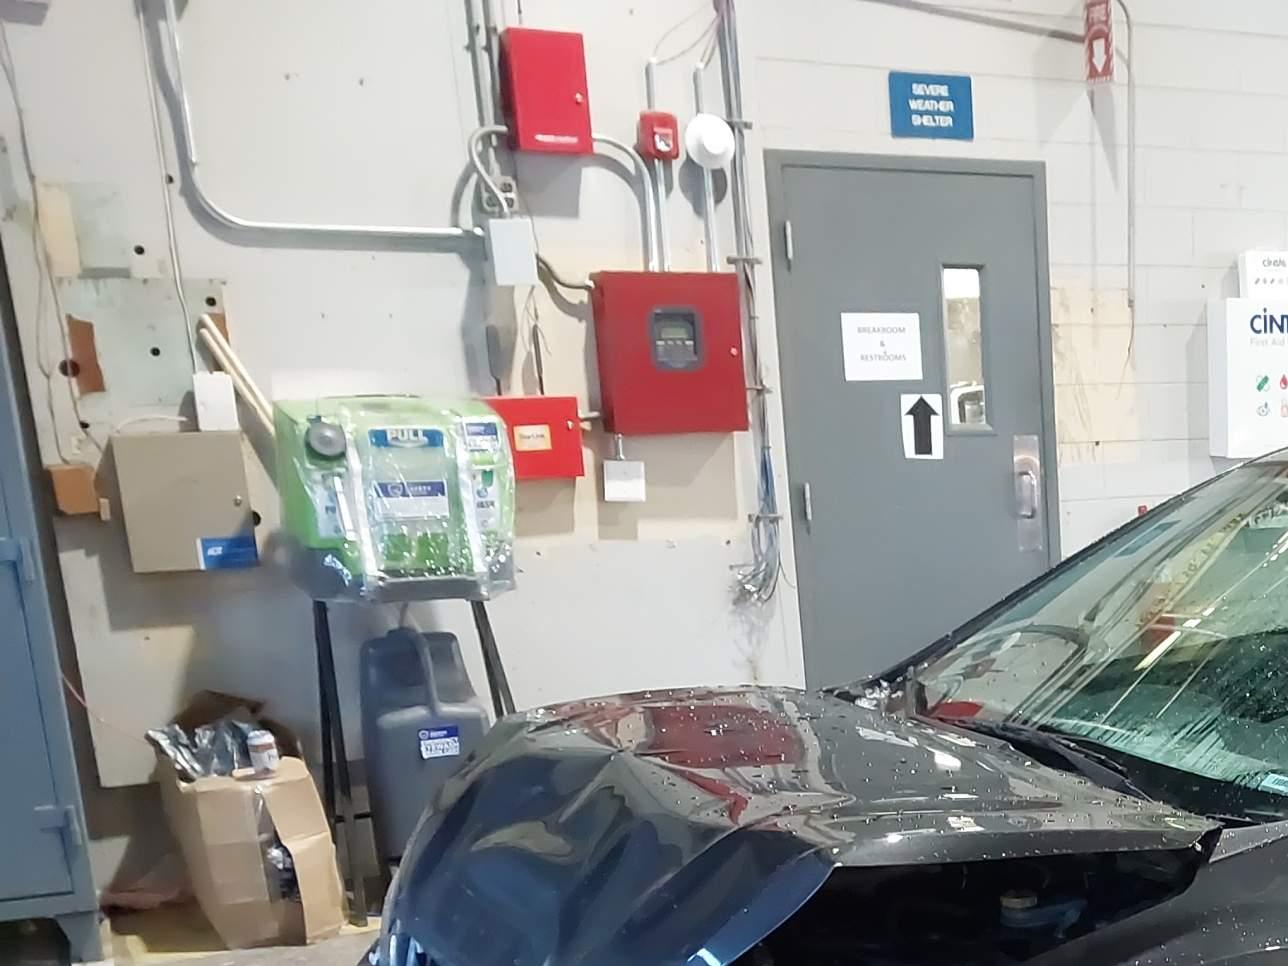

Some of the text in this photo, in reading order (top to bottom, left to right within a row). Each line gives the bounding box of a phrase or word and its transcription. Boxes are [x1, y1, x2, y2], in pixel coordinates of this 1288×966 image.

[911, 82, 949, 97] SEVERE
[908, 98, 954, 112] WEATHER
[911, 114, 953, 127] SHELTER
[857, 326, 906, 335] BREAKROOM
[879, 339, 886, 348] &
[860, 353, 907, 361] RESTROOMS
[386, 428, 428, 442] PULL
